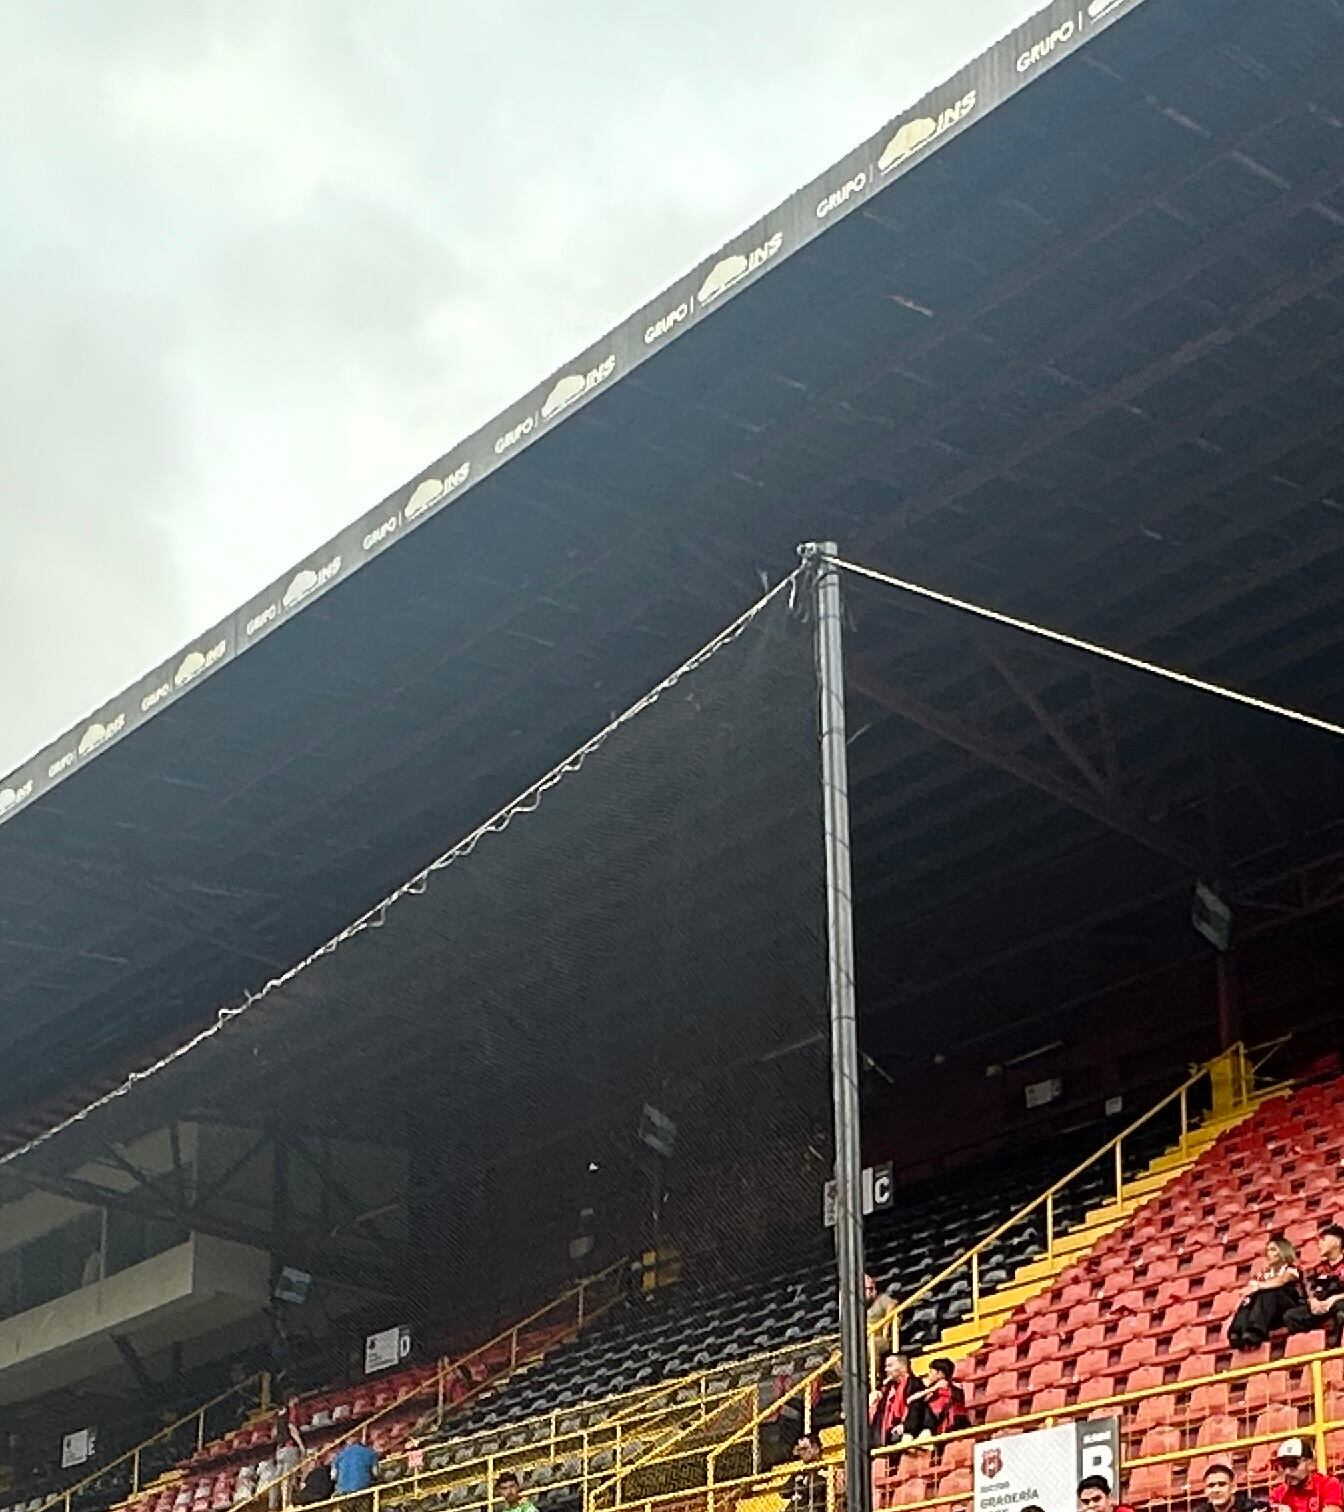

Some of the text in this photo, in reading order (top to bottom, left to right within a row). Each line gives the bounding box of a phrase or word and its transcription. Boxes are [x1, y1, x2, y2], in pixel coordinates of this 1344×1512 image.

[1016, 20, 1074, 73] GRUPO
[816, 90, 976, 218] GRUPO INS
[644, 232, 783, 344] GRUPO INS
[584, 354, 616, 391] INS
[874, 1176, 890, 1204] C
